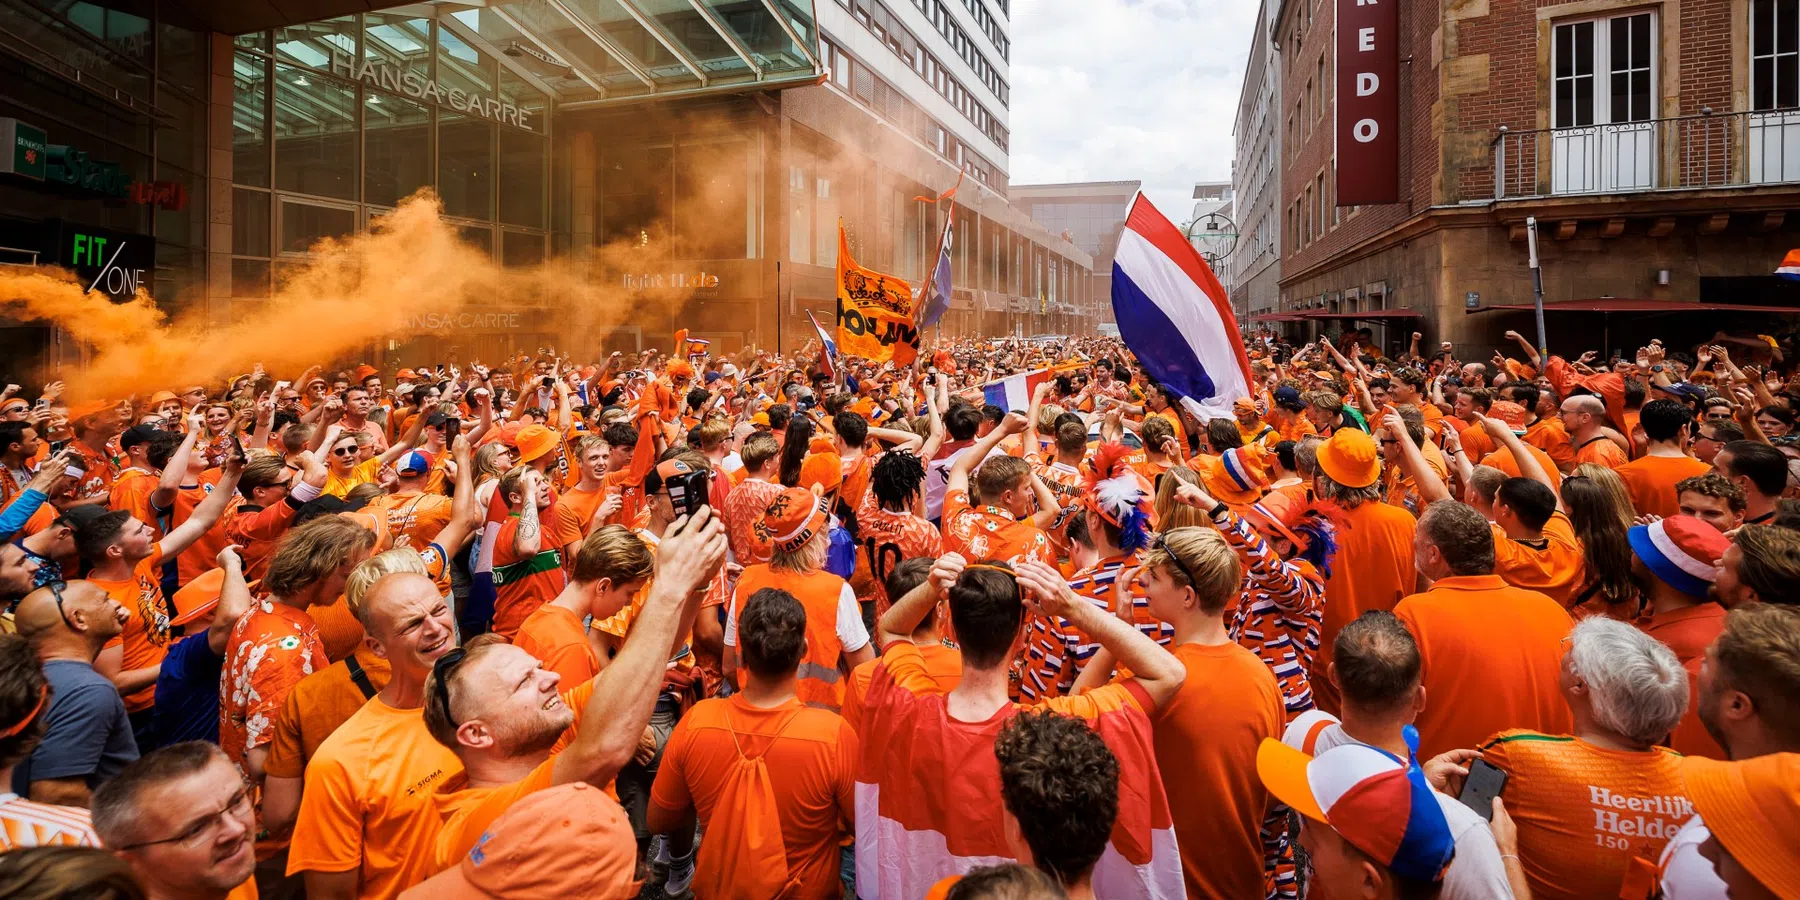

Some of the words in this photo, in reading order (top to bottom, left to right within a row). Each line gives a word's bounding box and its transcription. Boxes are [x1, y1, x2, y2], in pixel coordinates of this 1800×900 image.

[1353, 0, 1380, 142] EDO
[73, 233, 107, 267] FIT
[107, 266, 146, 295] ONE
[872, 520, 905, 535] GULLIT
[417, 768, 443, 788] SIGMA
[1587, 785, 1695, 819] Heerlijk
[1592, 808, 1683, 840] Helde
[1596, 833, 1629, 850] 150
